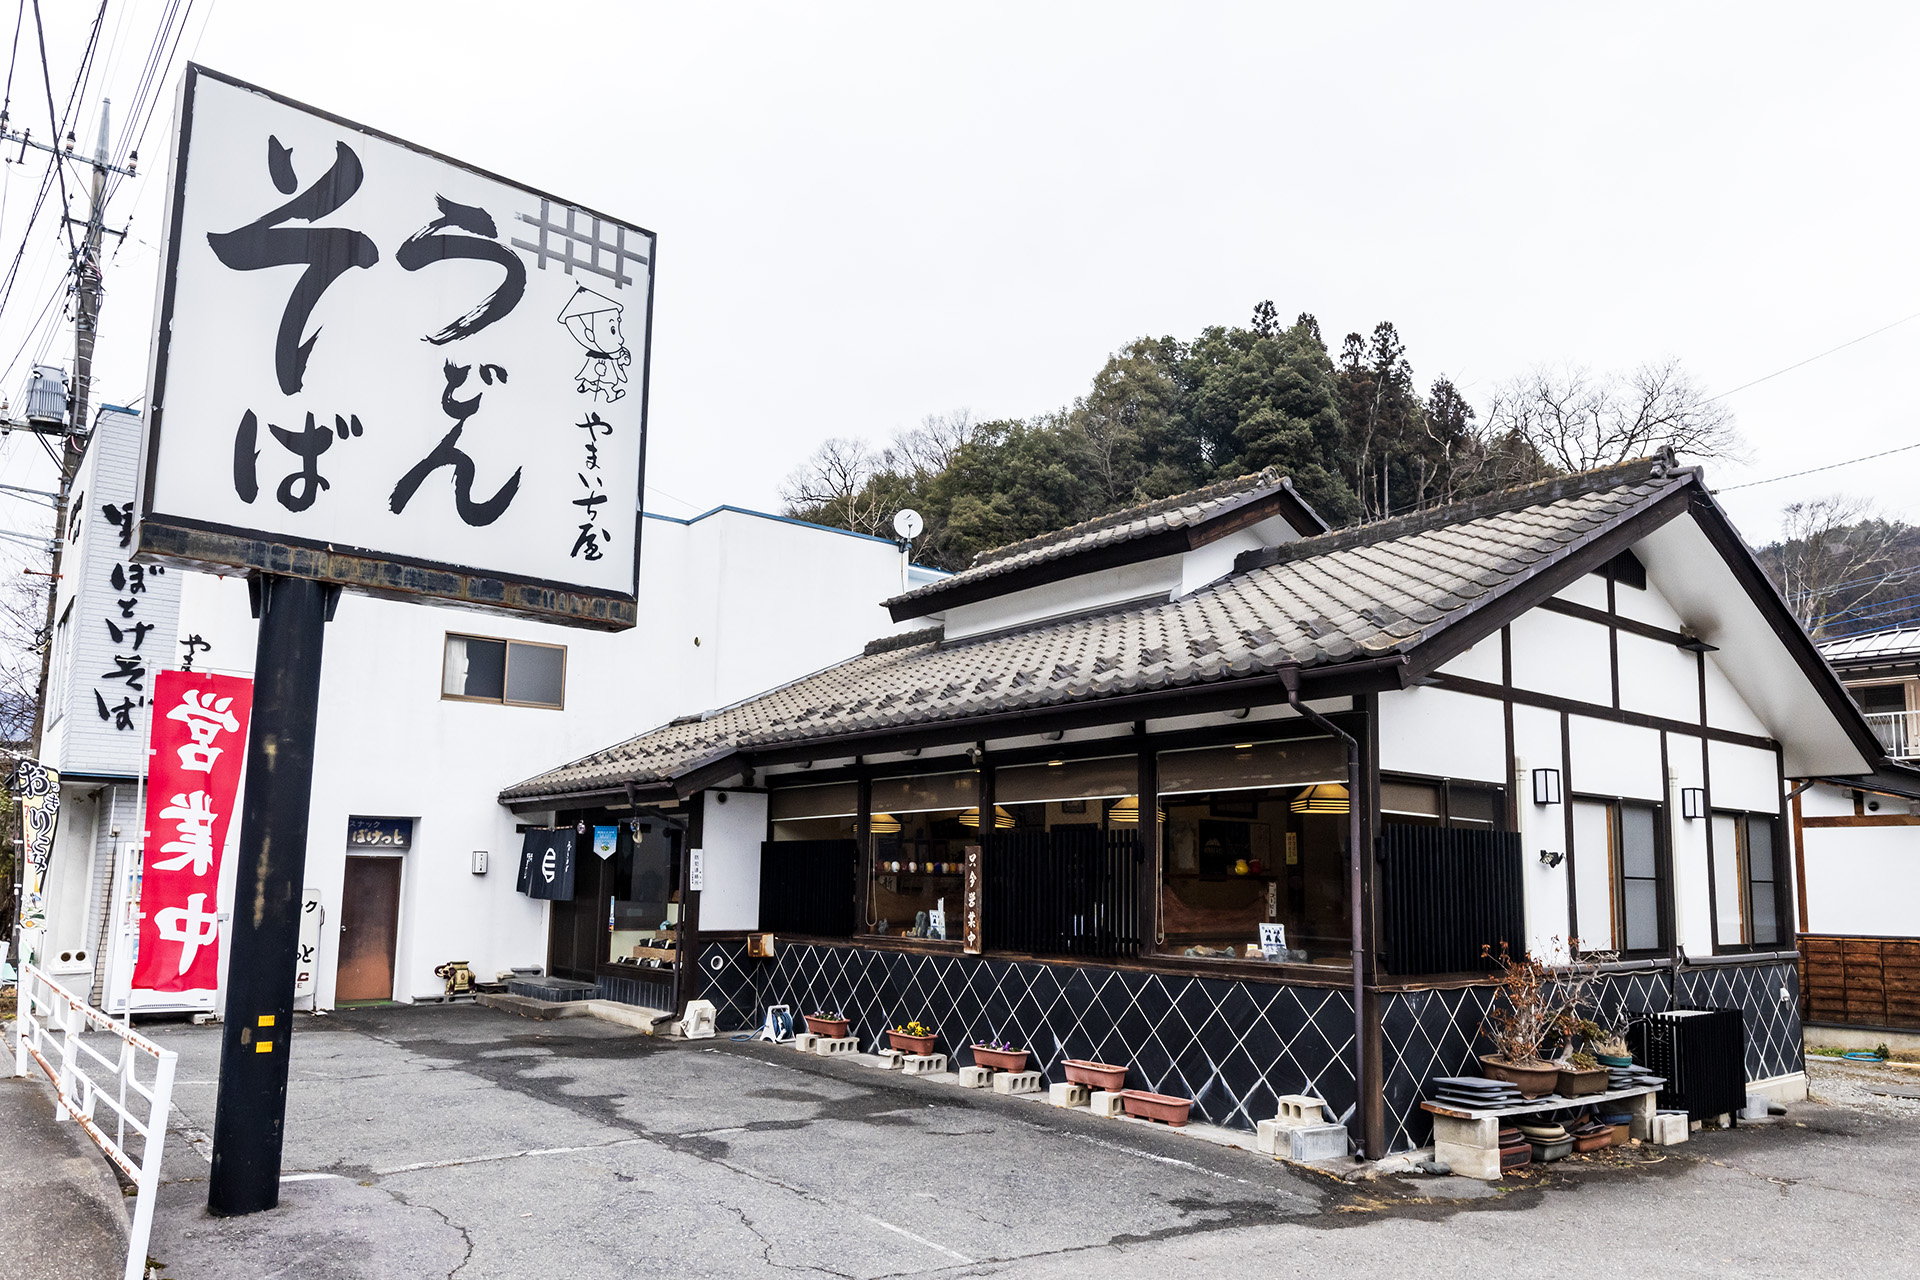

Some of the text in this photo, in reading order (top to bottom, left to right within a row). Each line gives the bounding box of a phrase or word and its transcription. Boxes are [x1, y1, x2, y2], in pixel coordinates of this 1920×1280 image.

[206, 134, 379, 512] そば
[388, 192, 528, 527] うどん
[570, 411, 613, 561] やまいち屋
[151, 688, 240, 977] 営業中
[350, 820, 381, 828] スナック
[966, 852, 978, 948] 只今営業中
